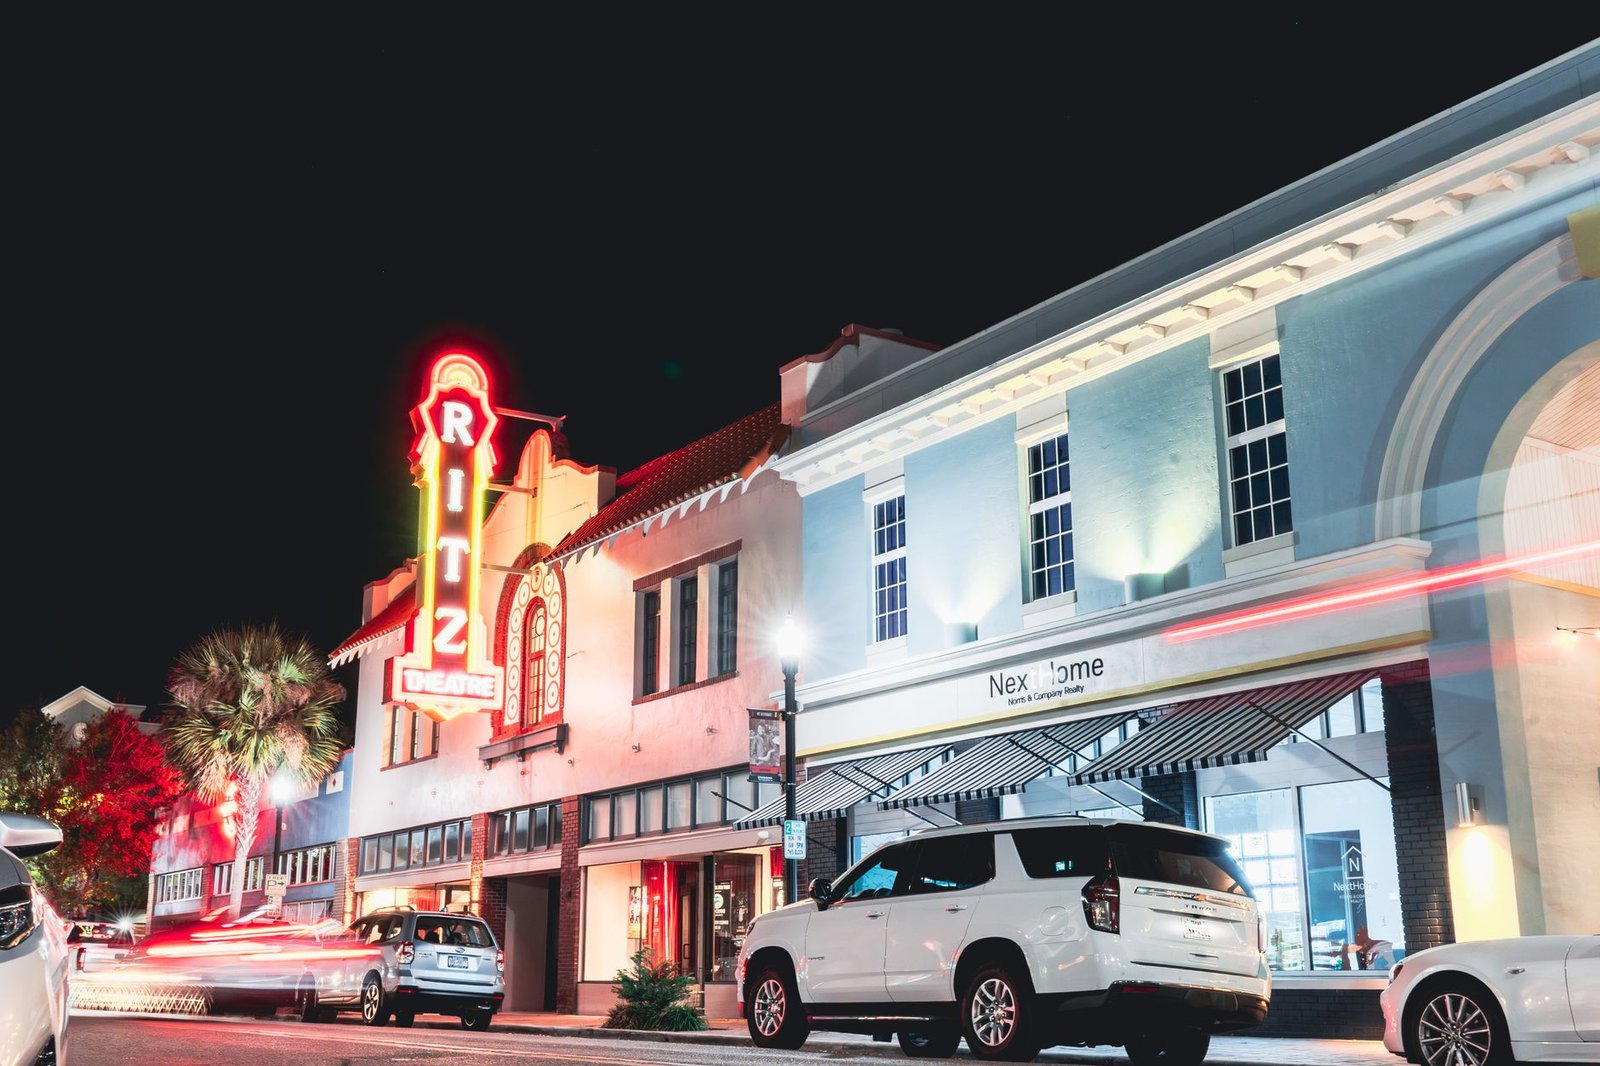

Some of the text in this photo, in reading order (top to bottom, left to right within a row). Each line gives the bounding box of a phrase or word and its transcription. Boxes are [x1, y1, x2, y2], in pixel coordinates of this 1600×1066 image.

[432, 400, 475, 655] RITZ
[403, 667, 495, 700] THEATRE
[989, 657, 1104, 699] NextHome
[1007, 684, 1085, 706] Norris & Company Realty
[1349, 857, 1360, 872] N
